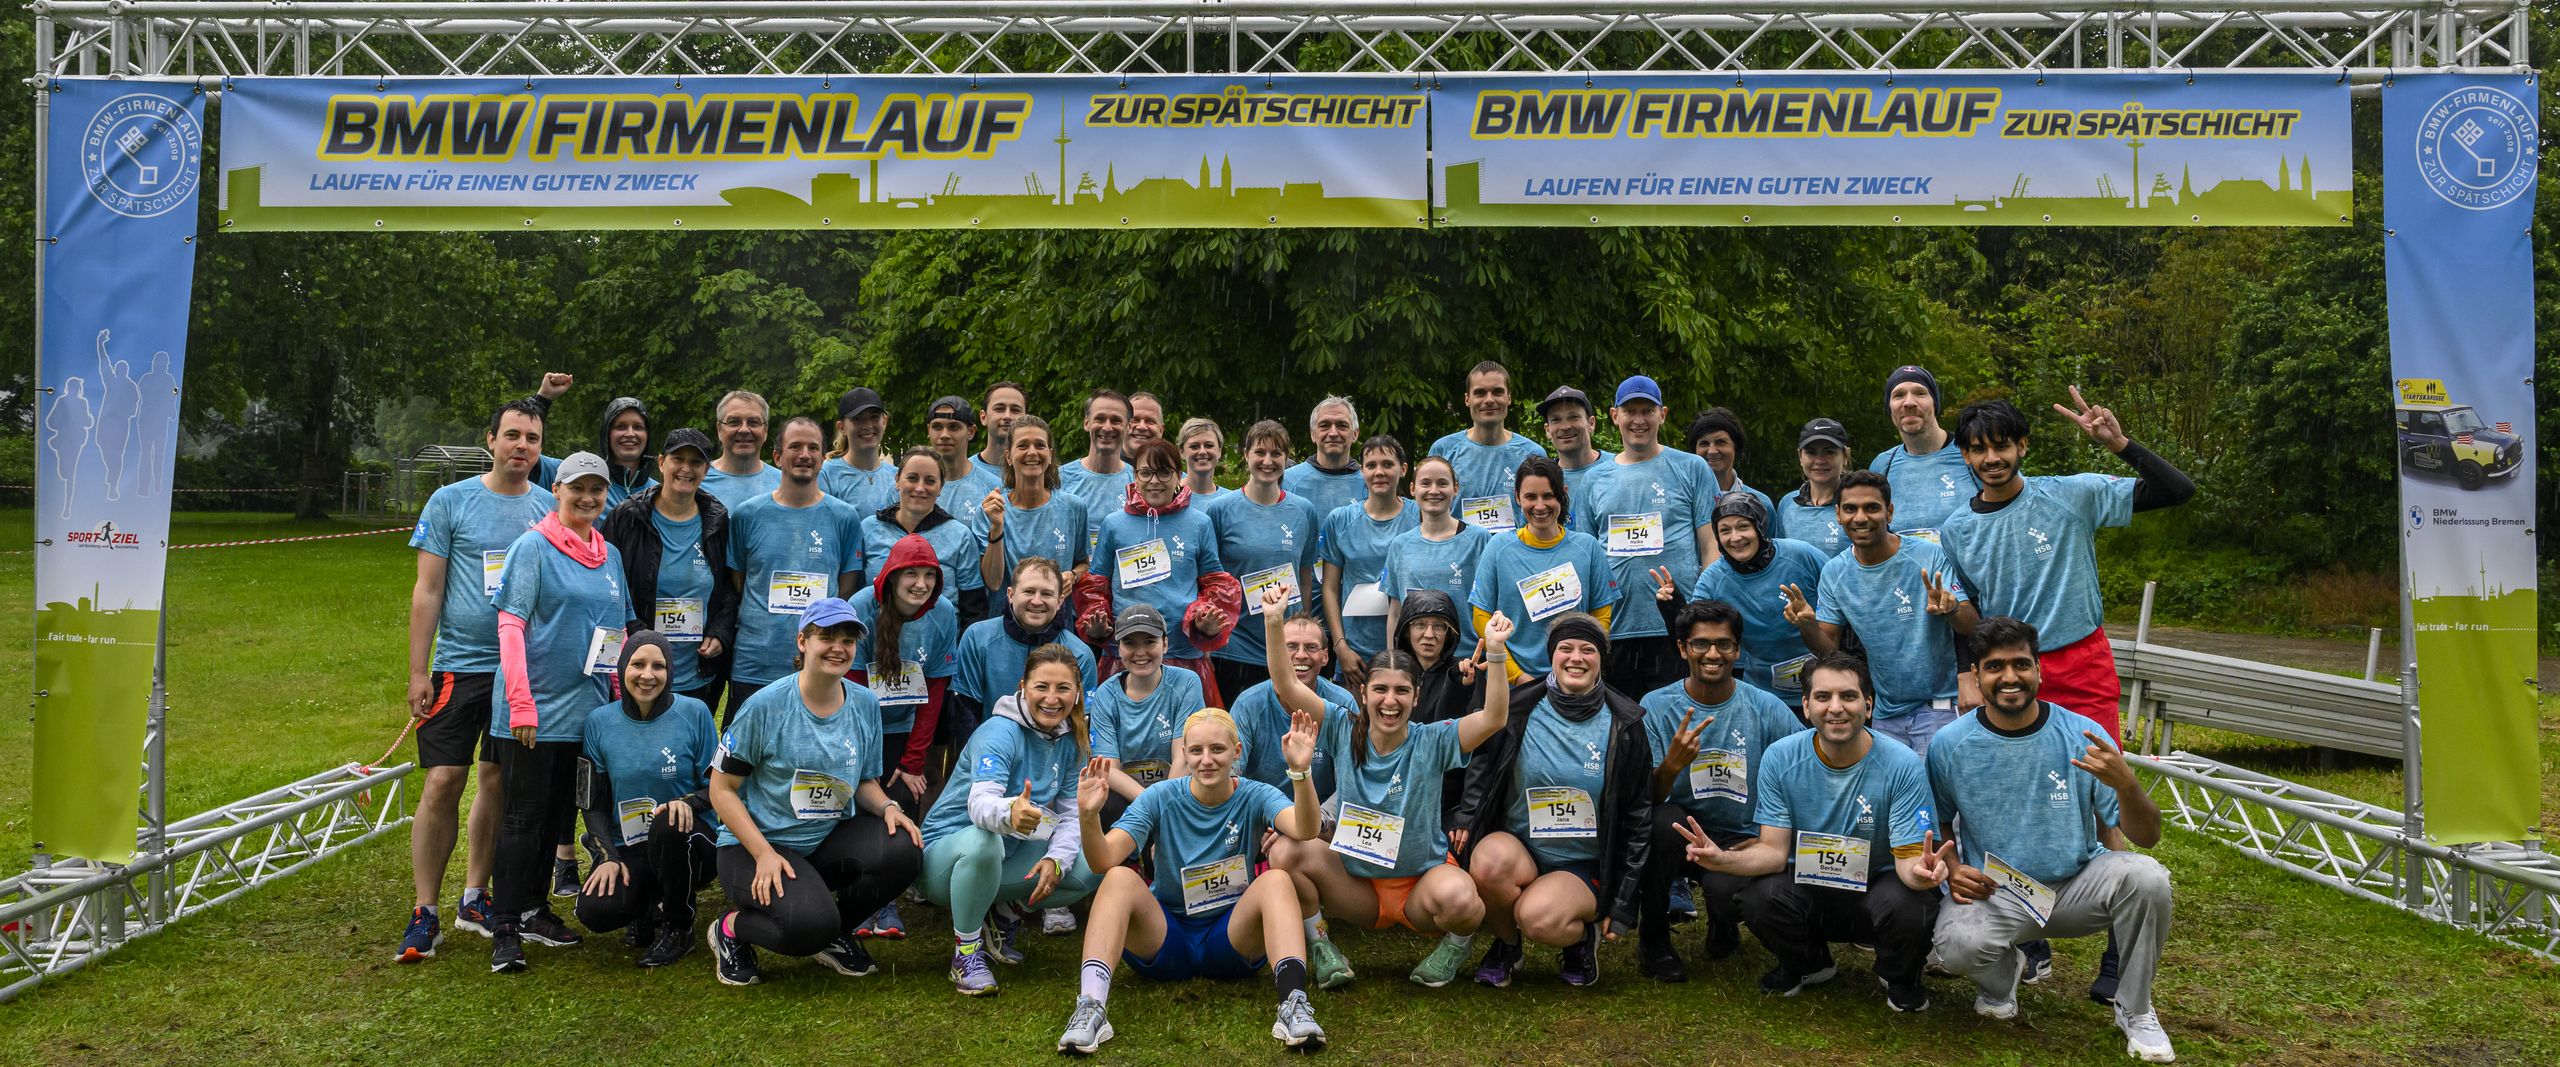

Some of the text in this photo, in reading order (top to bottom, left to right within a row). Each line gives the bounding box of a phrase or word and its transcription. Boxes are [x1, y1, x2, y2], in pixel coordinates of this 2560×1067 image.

[1087, 87, 1423, 127] ZUR SPÄTSCHICHT
[1475, 91, 1998, 136] BMW FIRMENLAUF
[2003, 103, 2299, 138] ZUR SPÄTSCHICHT
[2424, 92, 2534, 141] BMW-FIRMENLAUF
[90, 99, 198, 150] BMW-FIRMENLAUF
[323, 96, 1028, 158] BMW FIRMENLAUF
[2503, 129, 2513, 153] 2008
[169, 137, 178, 160] 2008
[89, 166, 109, 195] ZUR
[309, 170, 700, 192] LAUFEN FÜR EINEN GUTEN ZWECK
[1524, 172, 1933, 197] LAUFEN FÜR EINEN GUTEN ZWECK
[2423, 159, 2532, 204] ZUR SPÄTSCHICHT
[1476, 508, 1499, 520] 154
[2433, 508, 2457, 517] BMW
[2433, 518, 2525, 526] Niederlassung Bremen
[67, 532, 139, 544] SPORT ZIEL
[1625, 527, 1649, 540] 154
[2034, 543, 2052, 554] HSB
[1134, 555, 1157, 570] 154
[786, 585, 811, 598] 154
[1539, 581, 1565, 597] 154
[1897, 606, 1913, 614] HSB
[660, 612, 686, 624] 154
[2429, 622, 2448, 631] trade
[2455, 622, 2468, 631] far
[66, 633, 83, 642] trade
[87, 634, 98, 644] far
[100, 635, 116, 644] run
[1158, 729, 1173, 738] HSB
[1583, 761, 1600, 770] HSB
[1707, 764, 1732, 779] 154
[1139, 768, 1164, 780] 154
[808, 786, 832, 799] 154
[1388, 785, 1403, 794] HSB
[2050, 792, 2069, 801] HSB
[1547, 802, 1576, 816] 154
[639, 811, 656, 824] 15
[1856, 816, 1874, 824] HSB
[1356, 823, 1383, 843] 154
[1816, 850, 1848, 867] 154
[1820, 864, 1843, 872] Berkan
[1202, 874, 1230, 890] 154
[2006, 872, 2034, 897] 154
